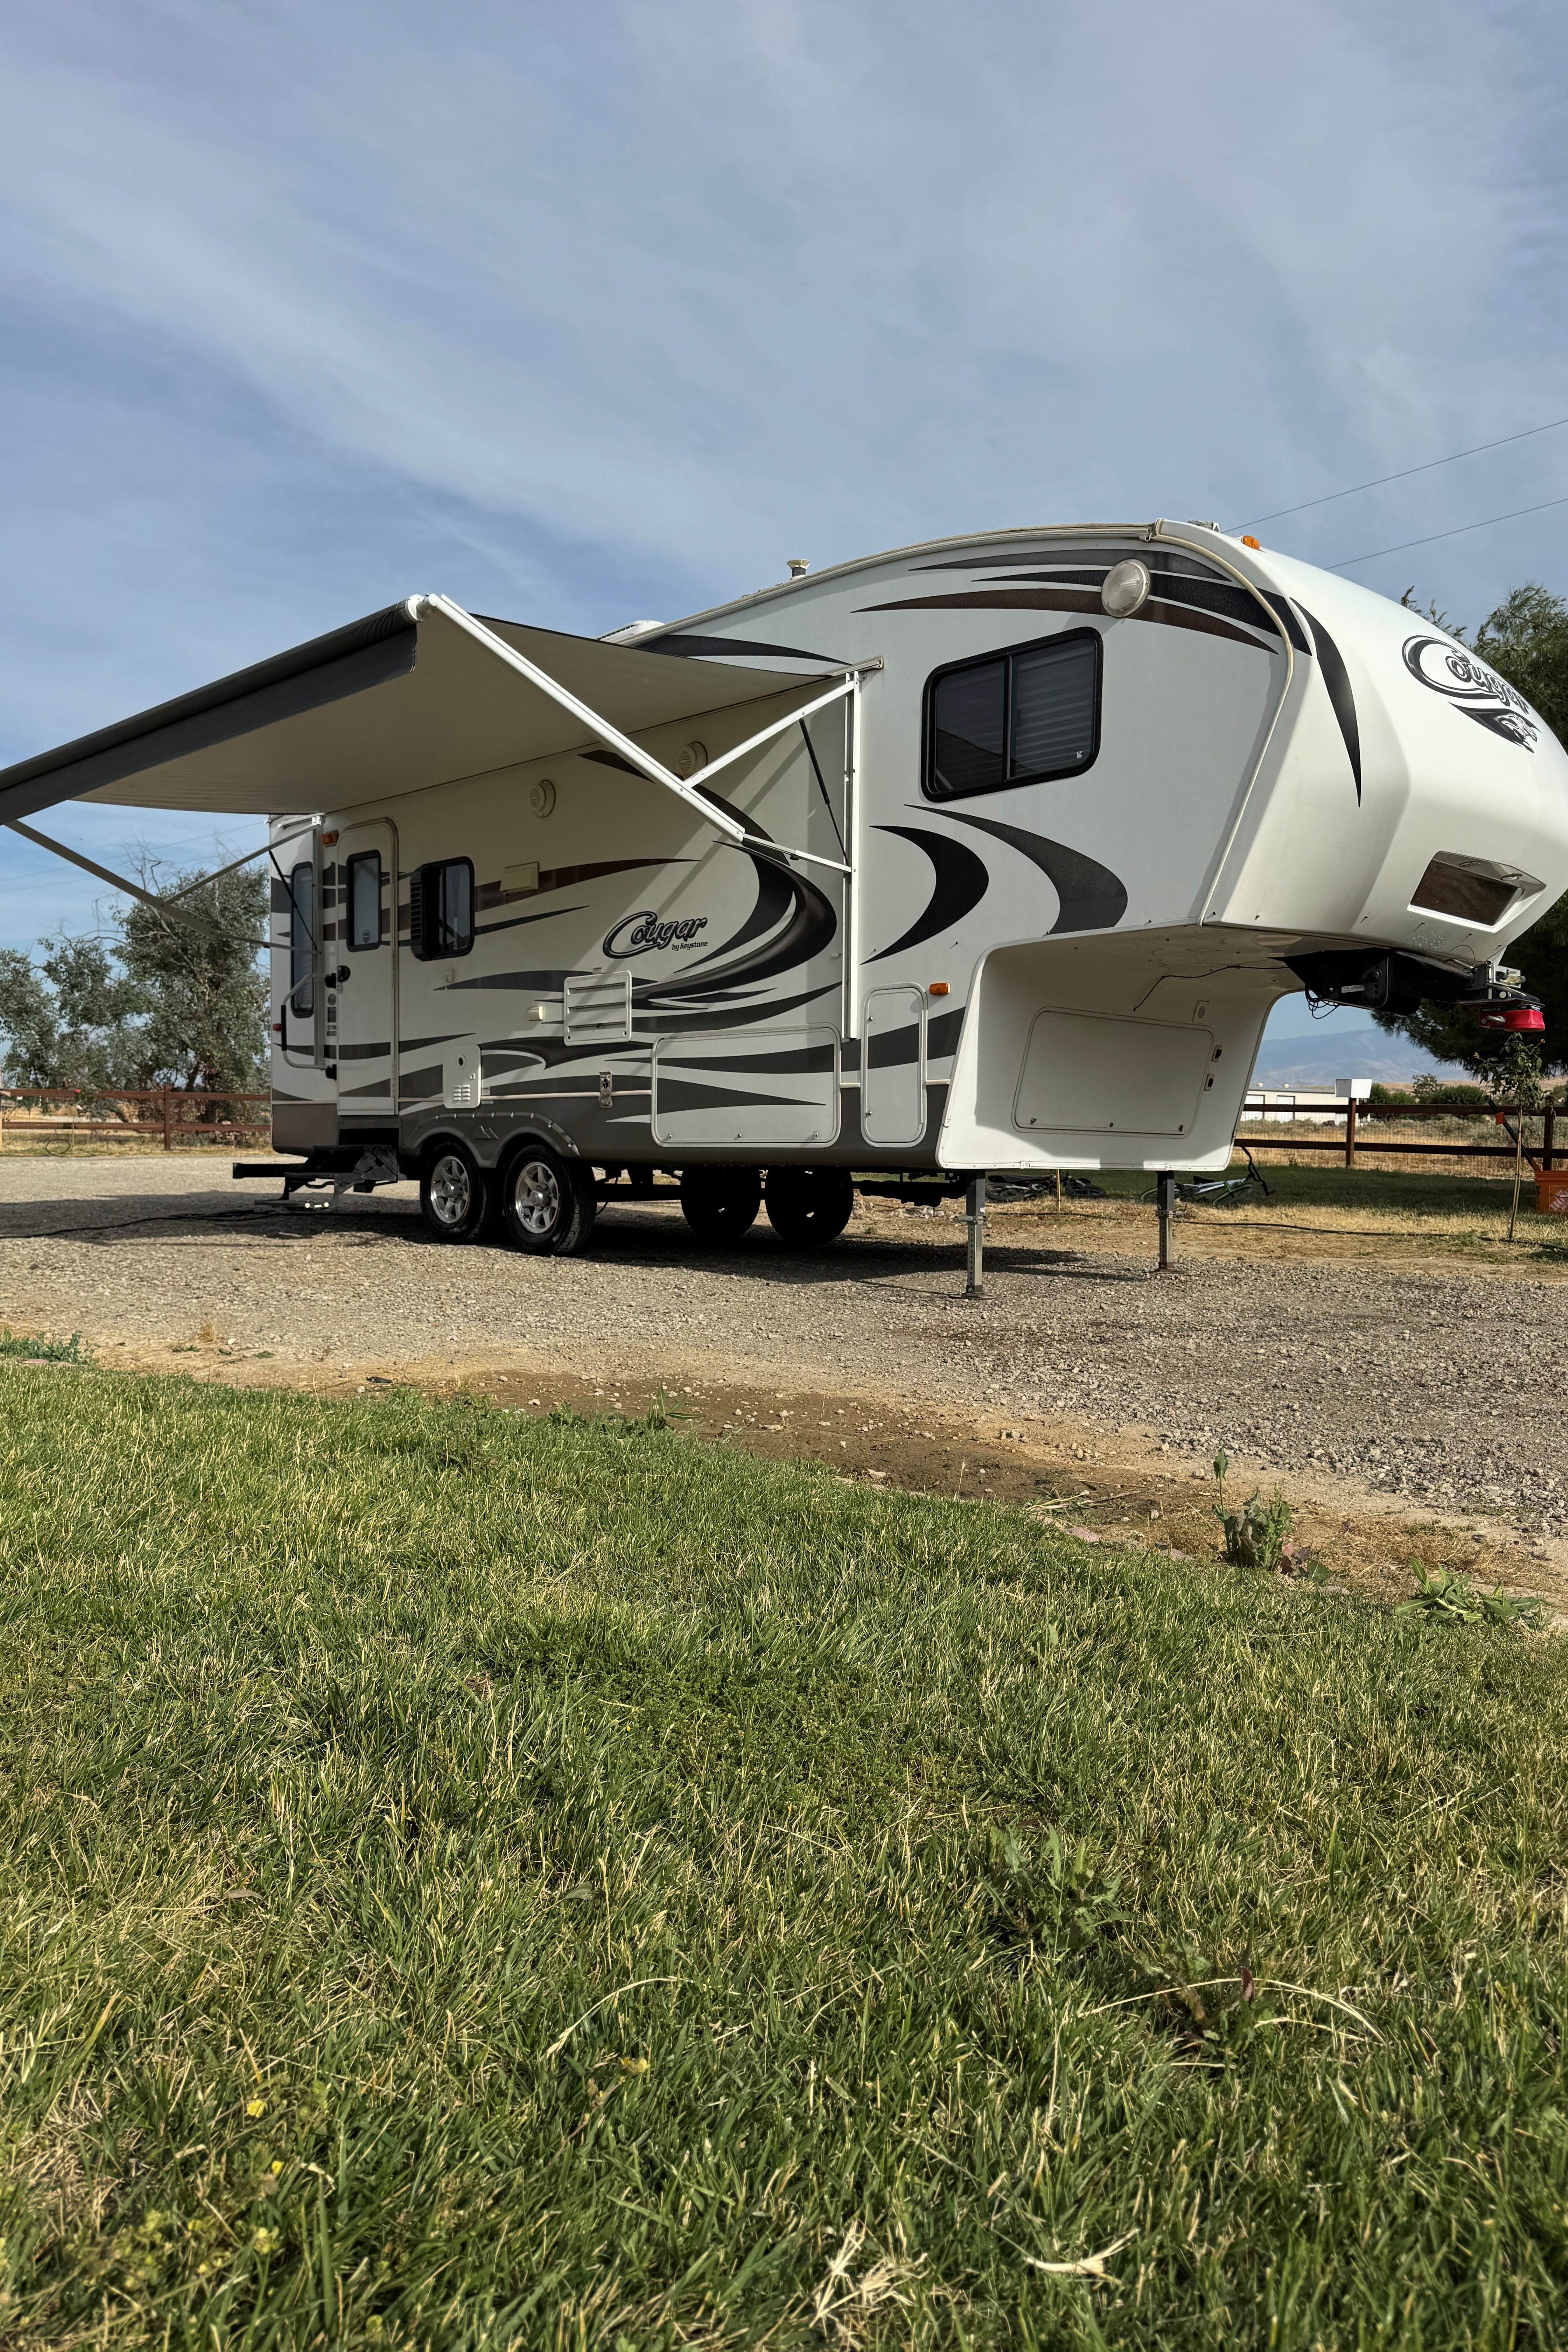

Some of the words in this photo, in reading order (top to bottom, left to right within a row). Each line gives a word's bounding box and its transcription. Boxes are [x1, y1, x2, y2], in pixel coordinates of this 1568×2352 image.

[1402, 635, 1529, 715] Cougar
[602, 911, 708, 959] Cougar
[680, 941, 708, 950] Keystone
